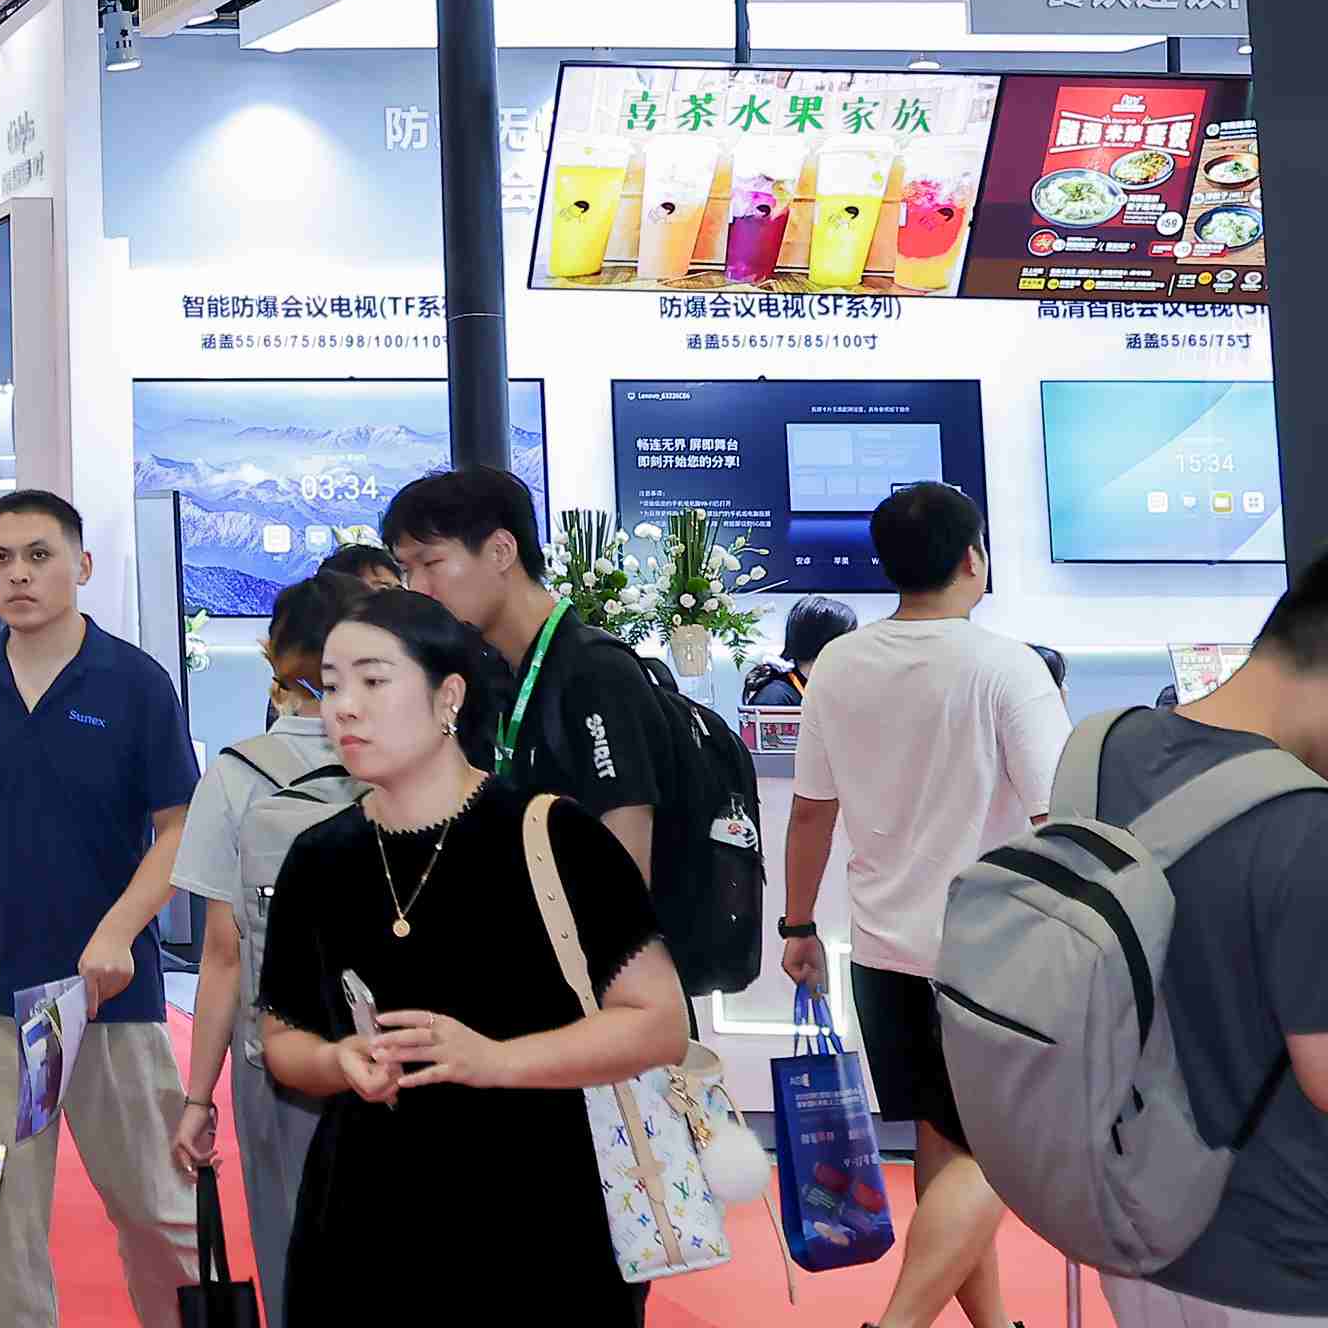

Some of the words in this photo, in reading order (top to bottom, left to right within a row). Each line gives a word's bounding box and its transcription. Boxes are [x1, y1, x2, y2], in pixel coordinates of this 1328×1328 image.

[626, 88, 933, 136] 喜茶水果家族
[182, 294, 448, 320] 智能防爆会议电视(TF系
[659, 294, 903, 321] 防爆会议电视(SF系列)
[686, 333, 879, 351] 涵盖55/65/75/85/100寸
[1125, 332, 1251, 351] 涵盖55/65/75寸
[637, 439, 686, 452] 畅连无界
[689, 439, 738, 452] 屏即舞台
[637, 455, 740, 470] 即刻开始您的分享!
[1175, 453, 1234, 473] 15:34
[301, 474, 379, 500] 03:34
